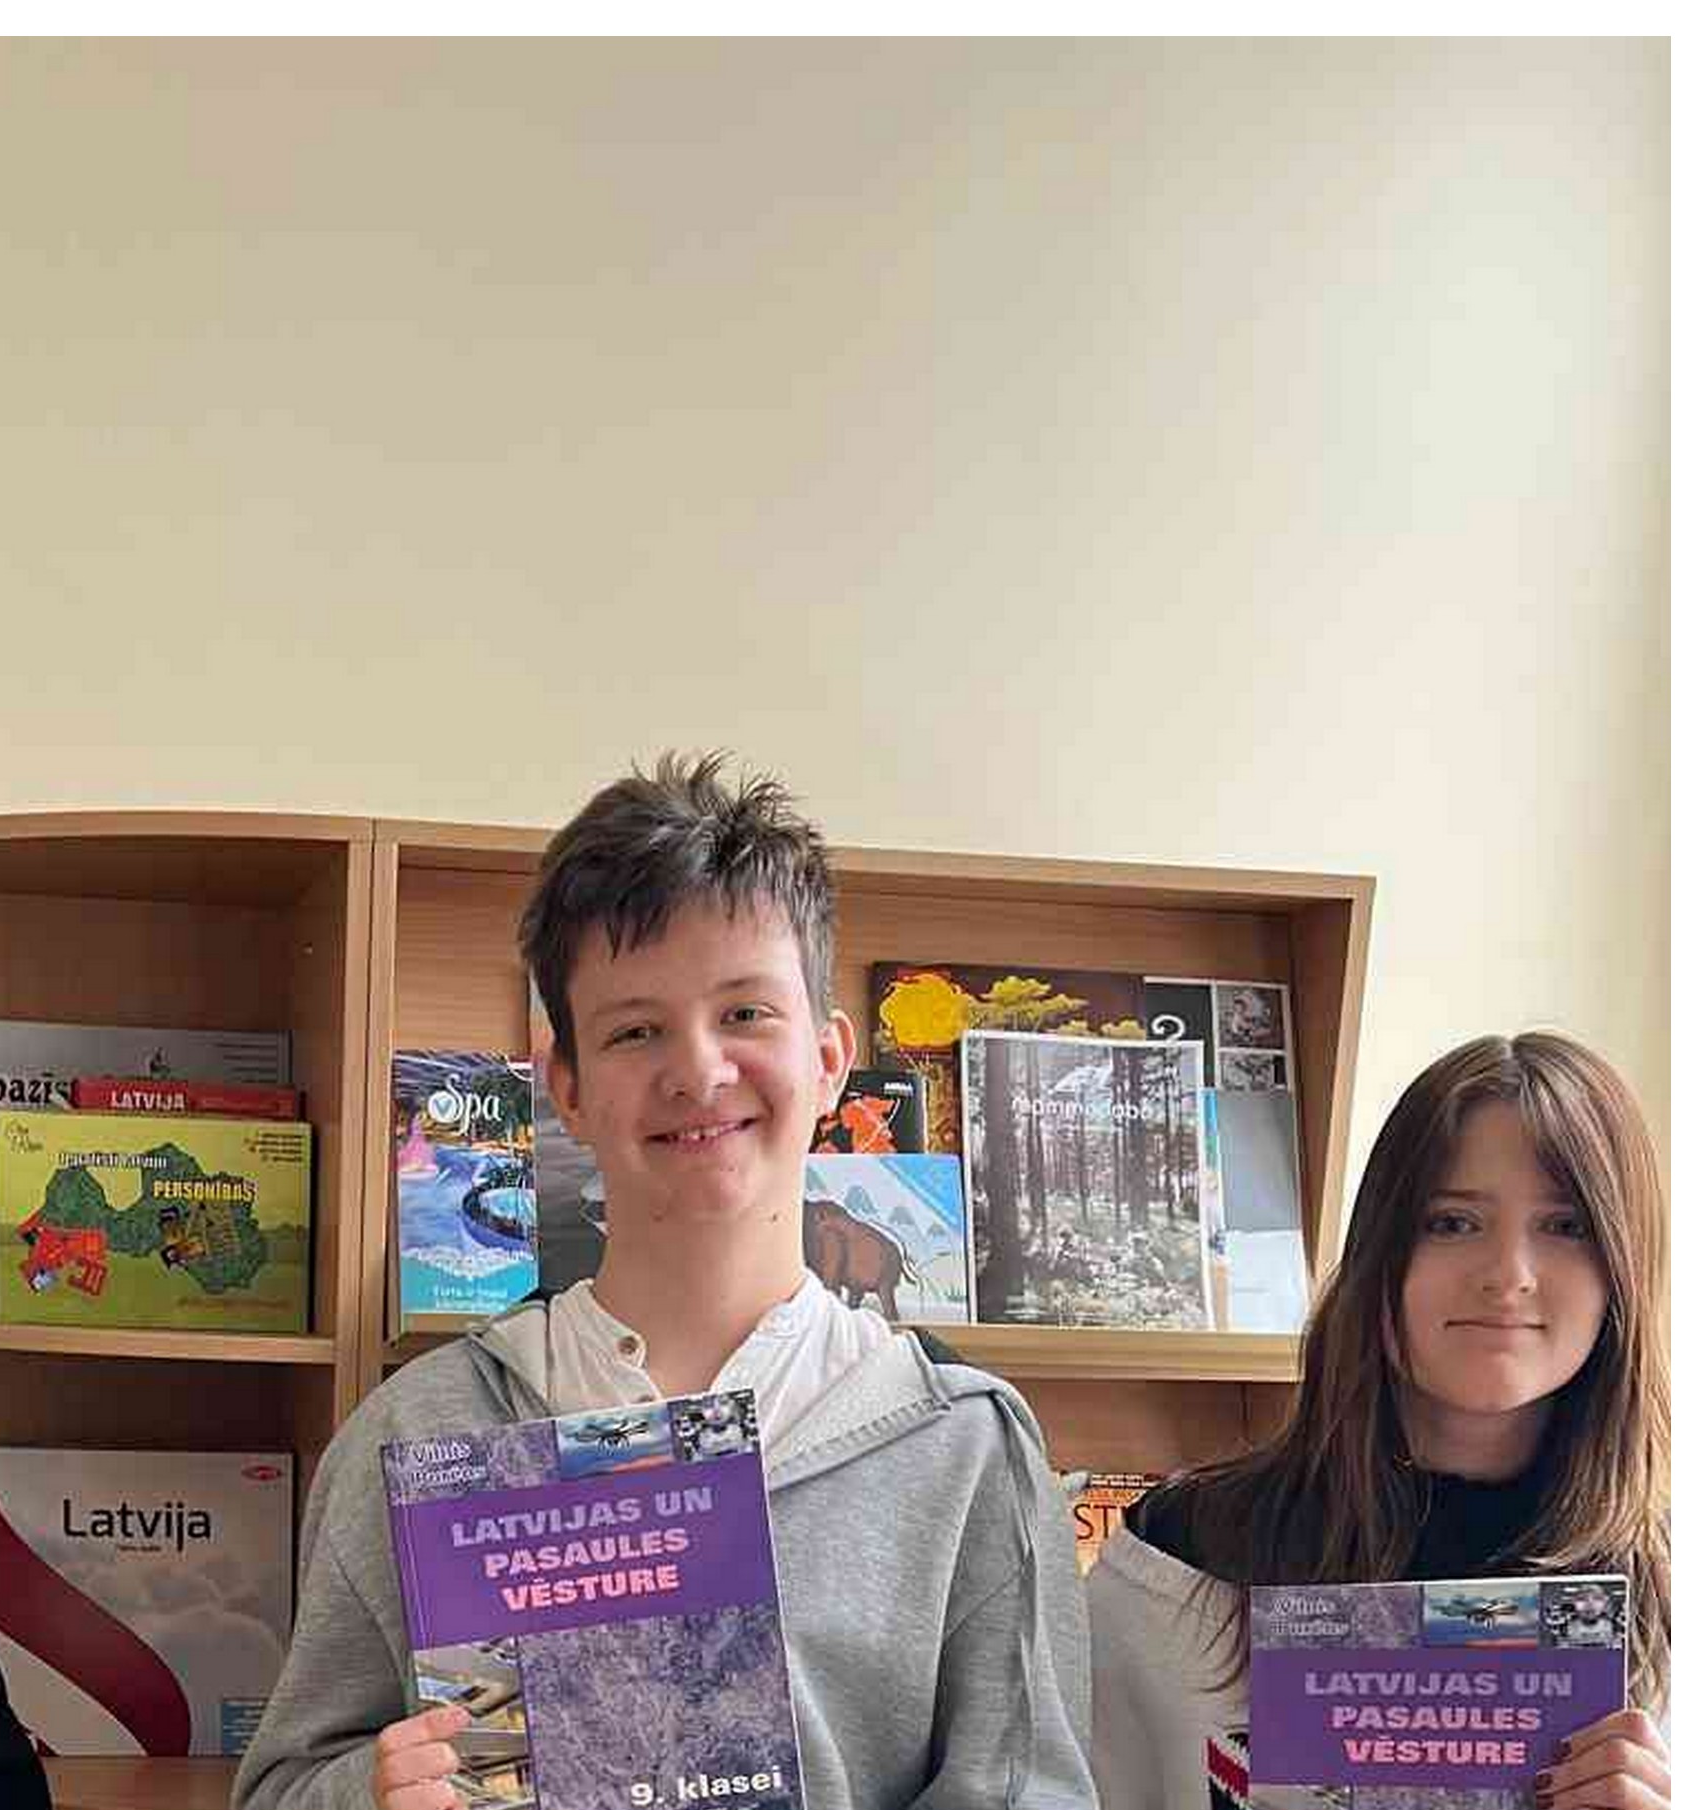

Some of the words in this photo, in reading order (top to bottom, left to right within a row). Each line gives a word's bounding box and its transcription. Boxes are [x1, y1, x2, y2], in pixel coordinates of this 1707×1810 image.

[110, 1090, 185, 1110] LATVIJA
[427, 1073, 503, 1137] Spa
[62, 1498, 212, 1552] Latvija
[450, 1497, 643, 1549] LATVIJAS
[653, 1486, 714, 1518] UN
[1073, 1503, 1128, 1541] ST
[483, 1526, 691, 1581] PASAULES
[499, 1563, 681, 1613] VĒSTURE
[1303, 1670, 1499, 1697] LATVIJAS
[1512, 1671, 1574, 1698] UN
[1331, 1704, 1543, 1732] PASAULES
[1342, 1734, 1528, 1766] VĒSTURE
[629, 1782, 667, 1807] 9.
[677, 1764, 783, 1800] klasei
